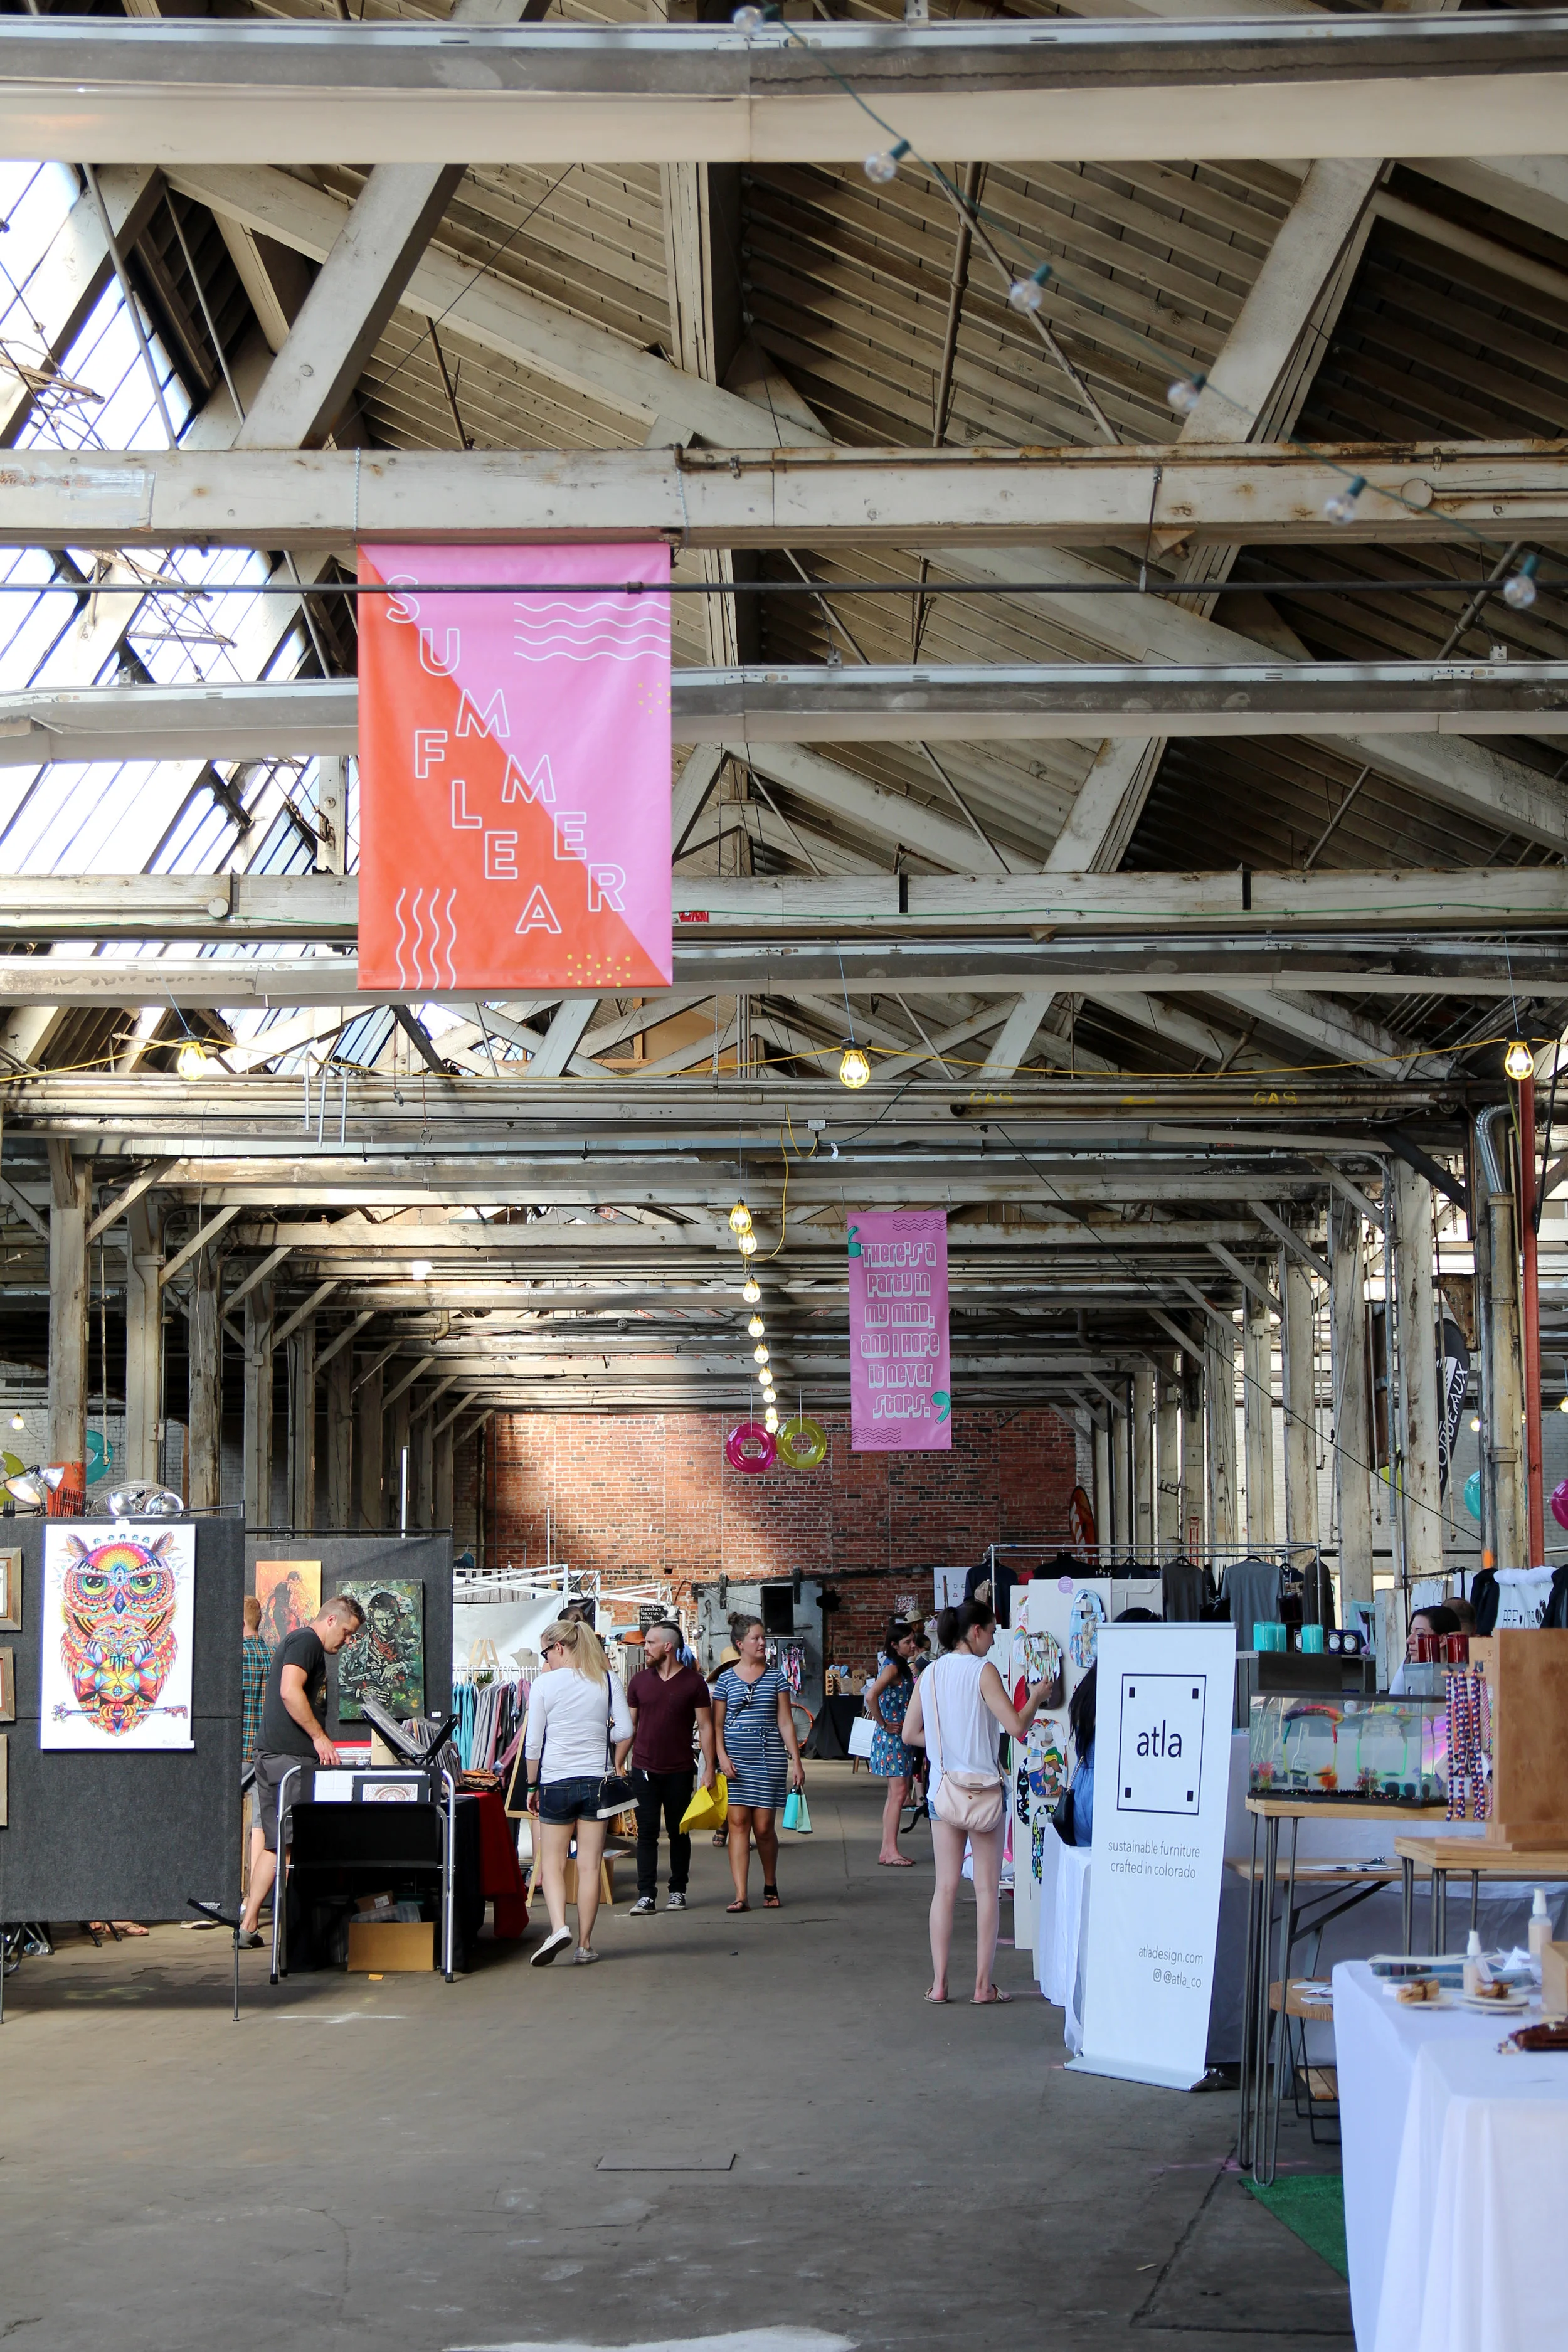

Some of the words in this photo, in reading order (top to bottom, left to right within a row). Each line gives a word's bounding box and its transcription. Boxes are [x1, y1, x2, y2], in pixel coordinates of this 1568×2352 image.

[386, 575, 625, 911] SUMMER
[415, 730, 562, 934] FLEA
[970, 1091, 1013, 1104] GAS
[1253, 1091, 1297, 1104] GAS
[924, 1242, 936, 1266] a
[914, 1273, 931, 1297] in
[892, 1333, 899, 1358] I
[868, 1364, 884, 1389] it
[1136, 1719, 1182, 1758] atla
[1108, 1840, 1158, 1855] sustainable
[1160, 1841, 1200, 1858] furniture
[1110, 1858, 1143, 1874] crafted
[1145, 1862, 1152, 1875] in
[1154, 1862, 1196, 1879] colorado
[1138, 1944, 1204, 1966] atladesign.com
[1163, 1970, 1202, 1989] @atla_co
